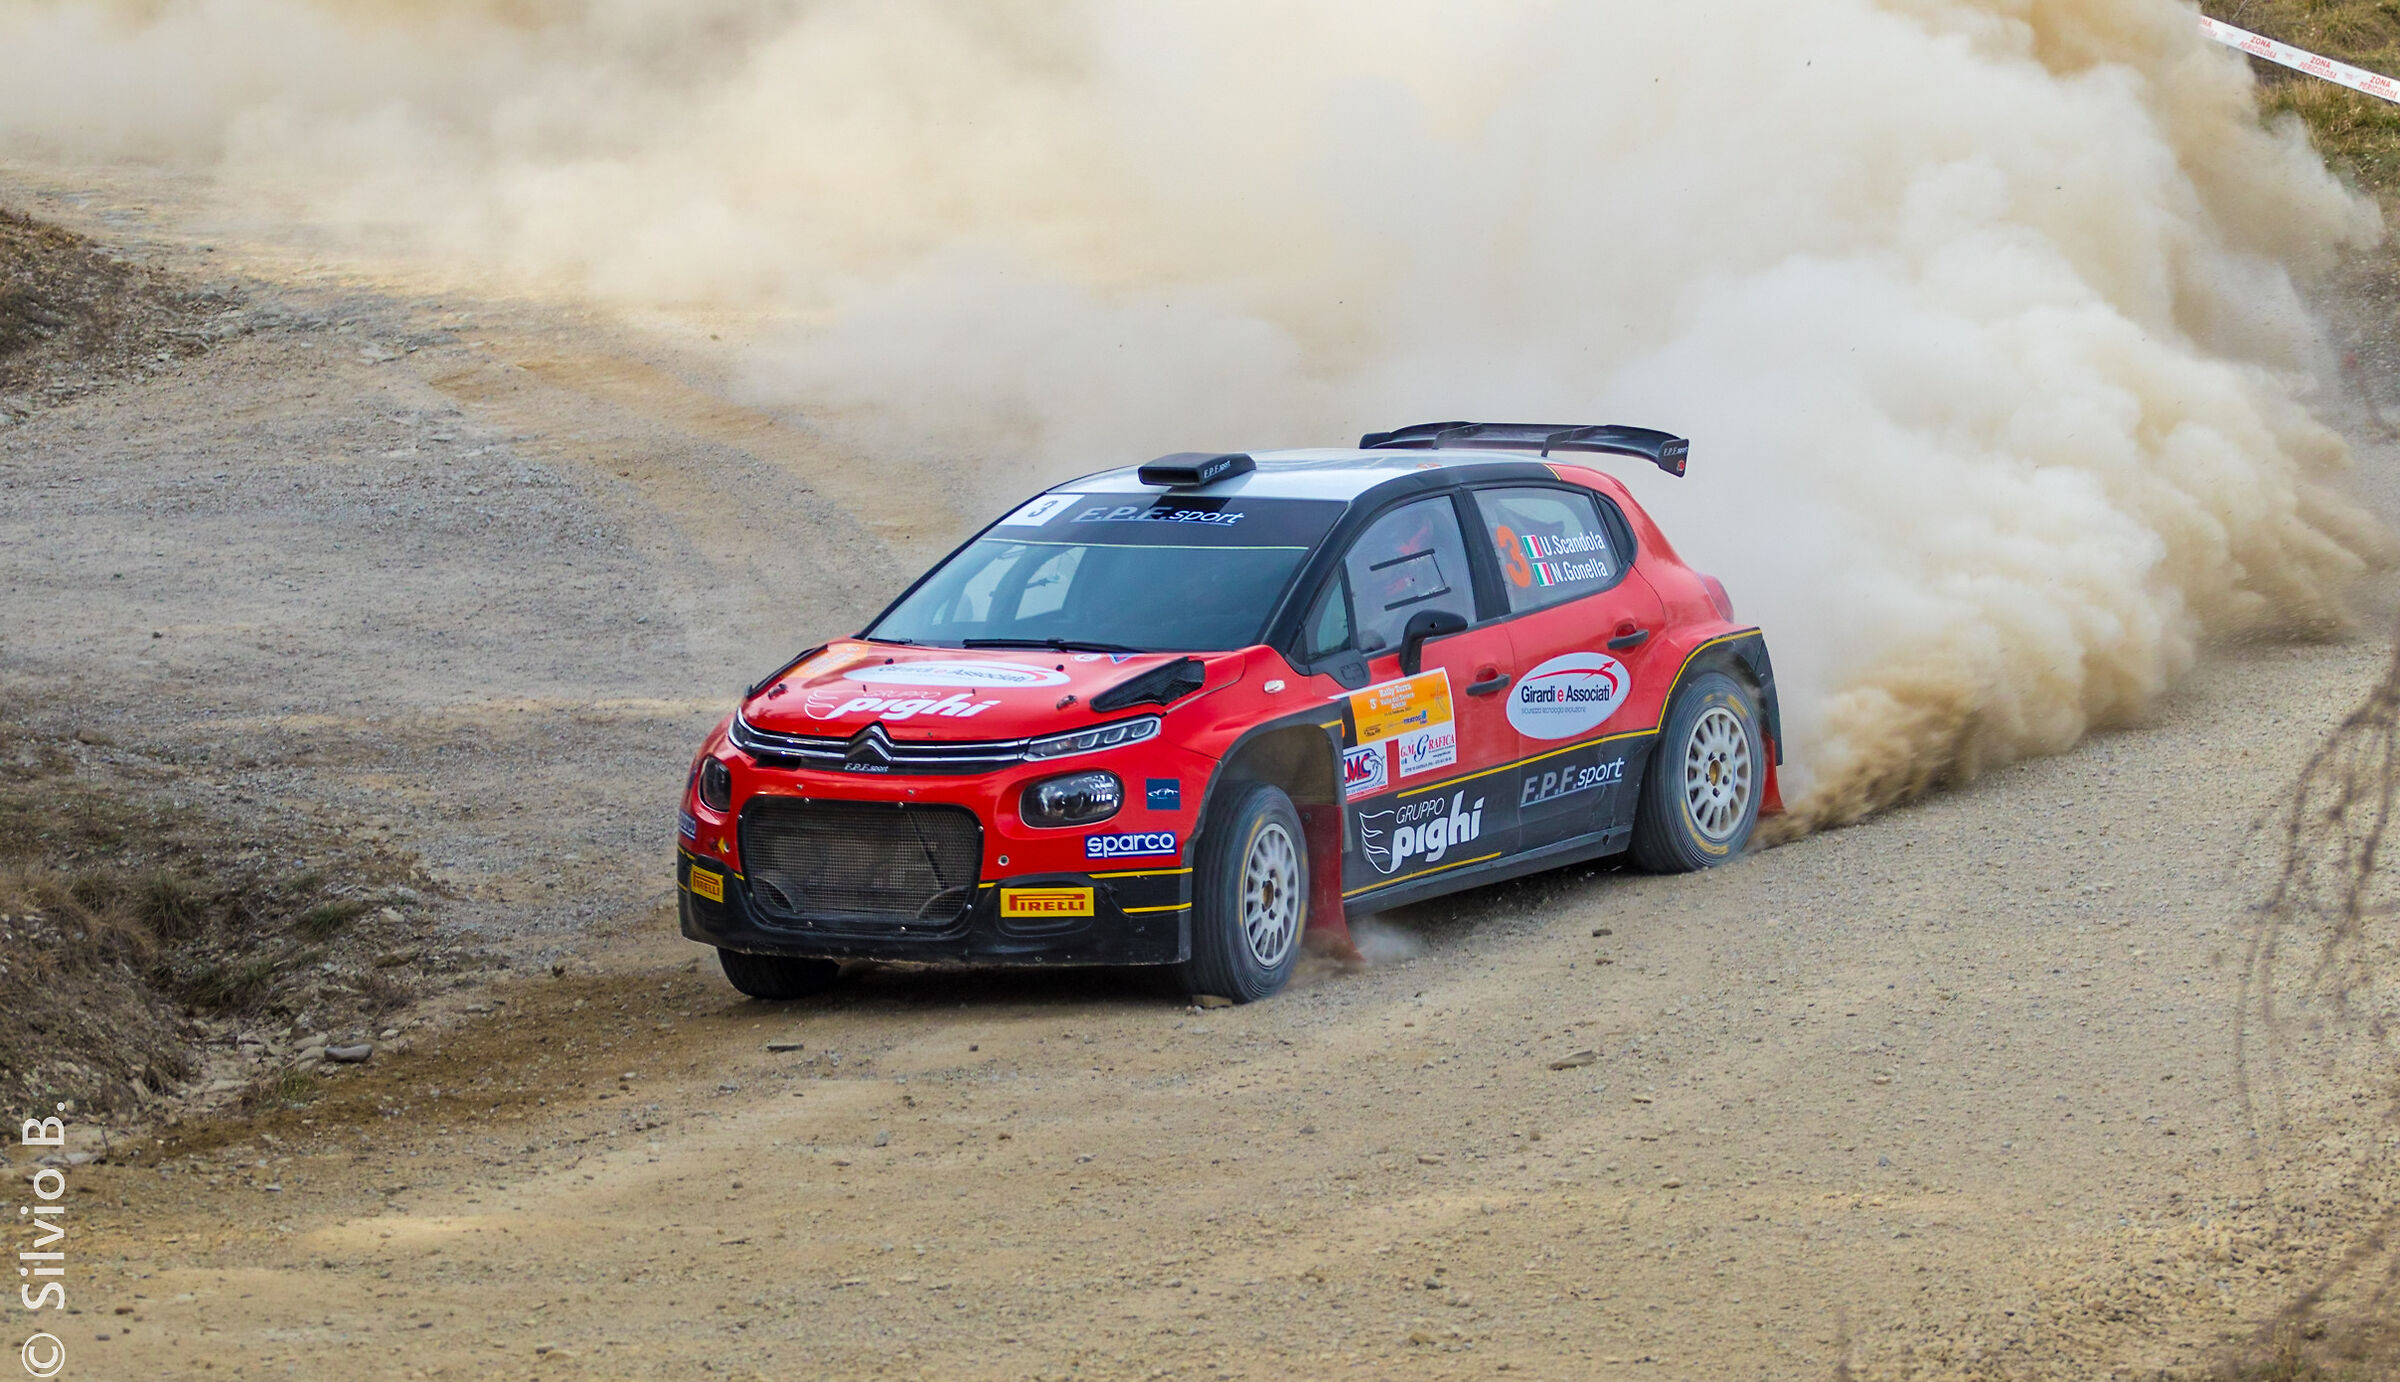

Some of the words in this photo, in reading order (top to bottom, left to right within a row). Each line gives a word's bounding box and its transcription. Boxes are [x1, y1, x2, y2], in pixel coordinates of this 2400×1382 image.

[2239, 40, 2278, 58] PERICOLOSA
[2250, 35, 2271, 48] ZONA
[2298, 61, 2337, 79] PERICOLOSA
[2310, 55, 2331, 68] ZONA
[2359, 81, 2398, 99] PERICOLOSA
[2370, 75, 2391, 88] ZONA
[1027, 500, 1059, 519] 3
[1540, 531, 1606, 556] U.Scandola
[1495, 525, 1532, 588] 3
[1549, 558, 1609, 583] N.Gonella
[1521, 685, 1556, 703] Girardi
[1557, 689, 1564, 702] e
[1565, 684, 1610, 702] Associati
[824, 693, 1002, 720] pighi
[1395, 797, 1445, 824] GRUPPO
[1389, 790, 1485, 873] pighi
[1087, 833, 1176, 858] sparco
[692, 870, 721, 897] PIRELLI
[1008, 893, 1086, 912] PIRELLI
